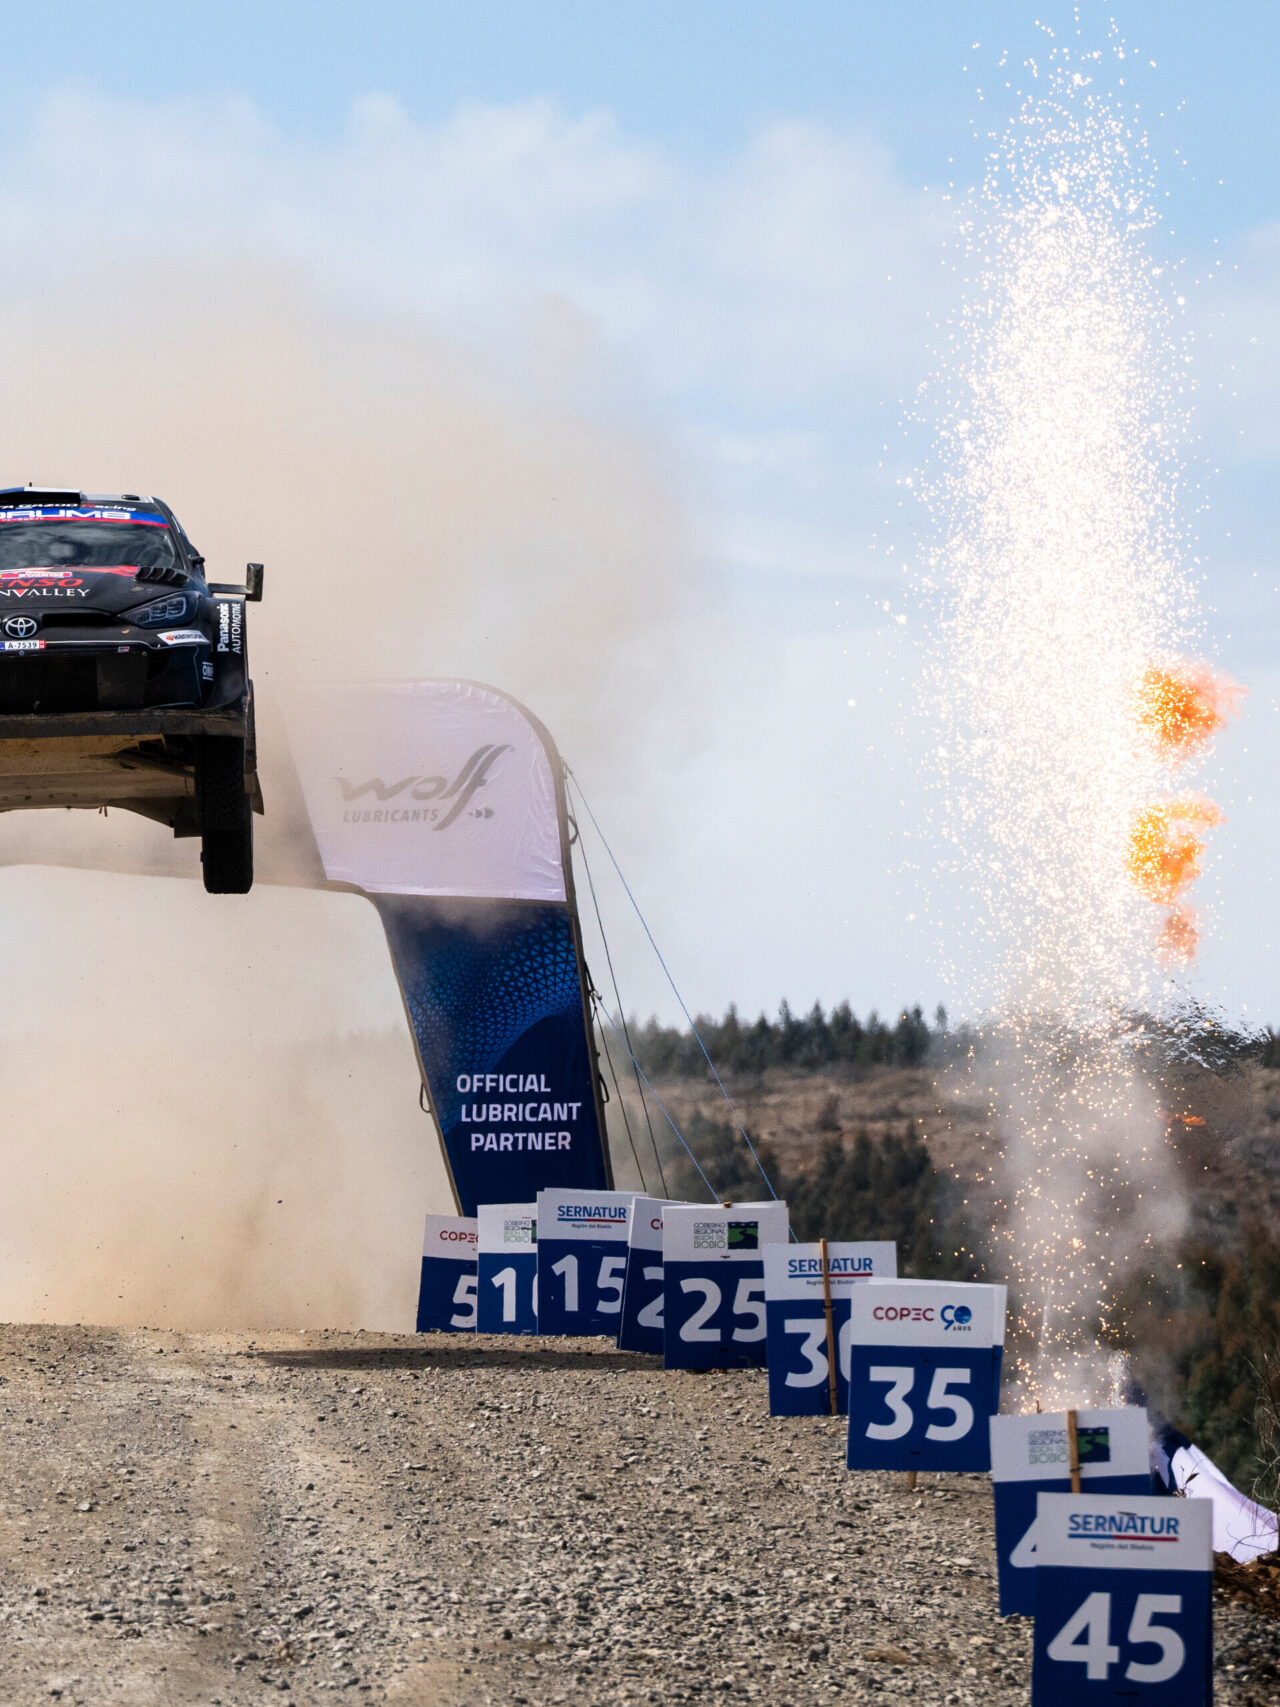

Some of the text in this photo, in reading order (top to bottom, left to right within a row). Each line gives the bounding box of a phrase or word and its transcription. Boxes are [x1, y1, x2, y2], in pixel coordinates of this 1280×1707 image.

[216, 602, 230, 652] Panasonic
[231, 602, 241, 654] AUTOMOTIVE
[342, 808, 438, 823] LUBRICANTS
[456, 1074, 551, 1093] OFFICIAL
[461, 1102, 582, 1122] LUBRICANT
[471, 1132, 572, 1151] PARTNER
[557, 1206, 627, 1218] SERNATUR
[450, 1274, 478, 1329] 5
[551, 1254, 627, 1314] 15
[637, 1266, 664, 1329] 2
[679, 1277, 767, 1342] 25
[873, 1306, 935, 1321] COPEC
[865, 1365, 974, 1442] 35
[1068, 1514, 1180, 1534] SERNATUR
[1047, 1592, 1186, 1684] 45
